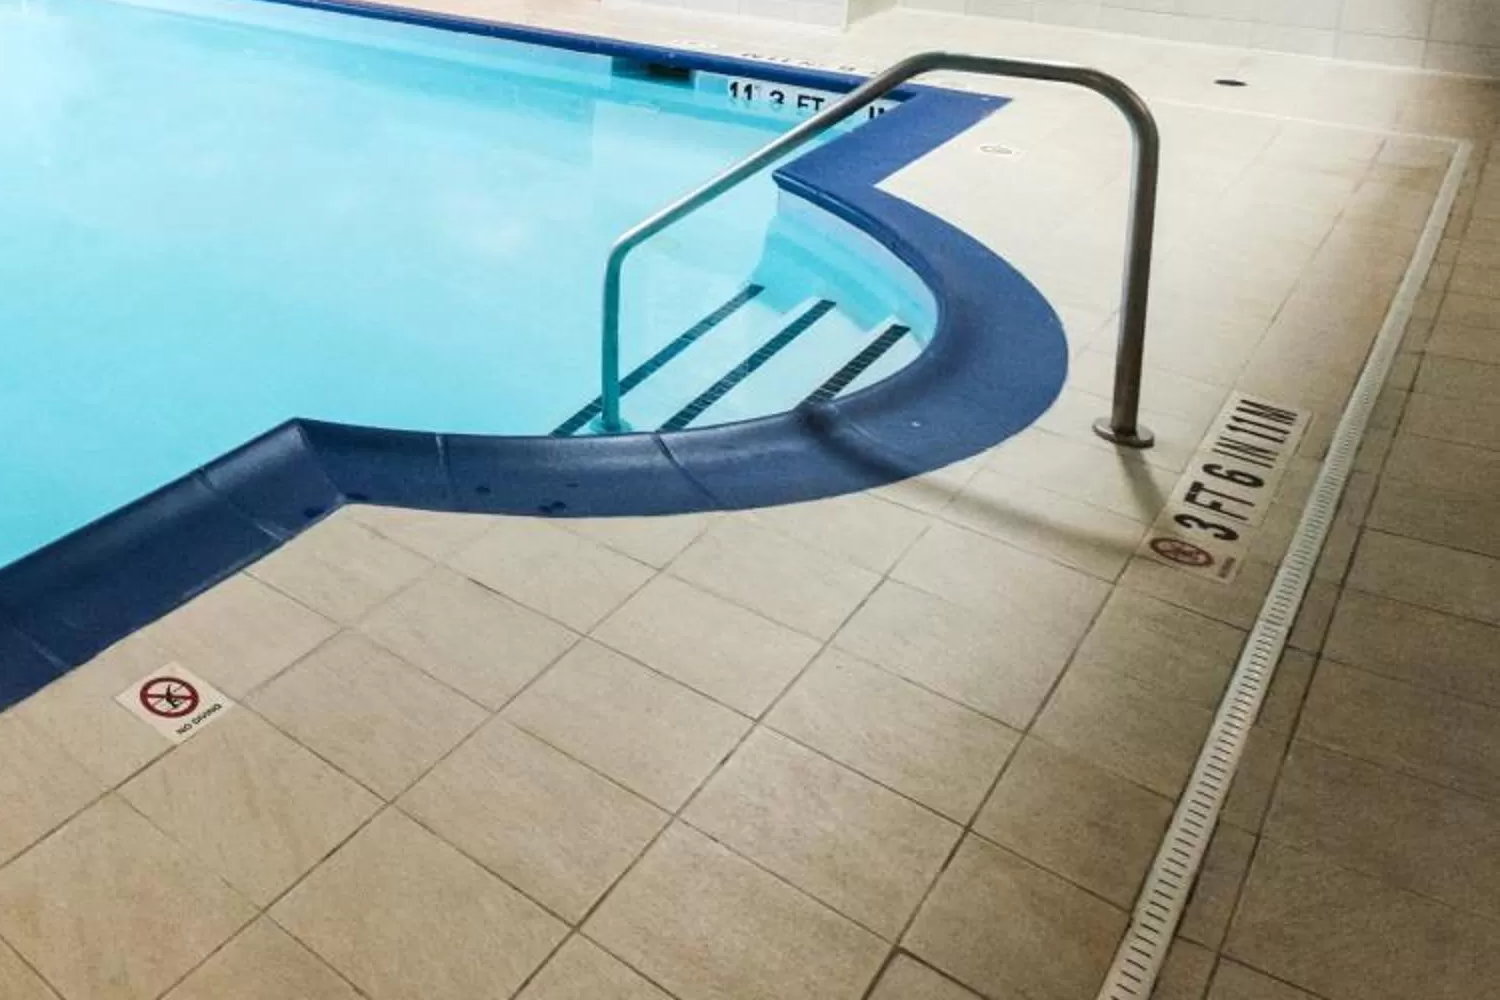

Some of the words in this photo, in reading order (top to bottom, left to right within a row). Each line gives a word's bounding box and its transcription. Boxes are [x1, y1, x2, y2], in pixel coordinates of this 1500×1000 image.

[797, 94, 825, 111] FT
[1211, 435, 1279, 469] IN
[1202, 463, 1265, 489] 6
[1184, 480, 1255, 521] FT
[1173, 513, 1239, 541] 3
